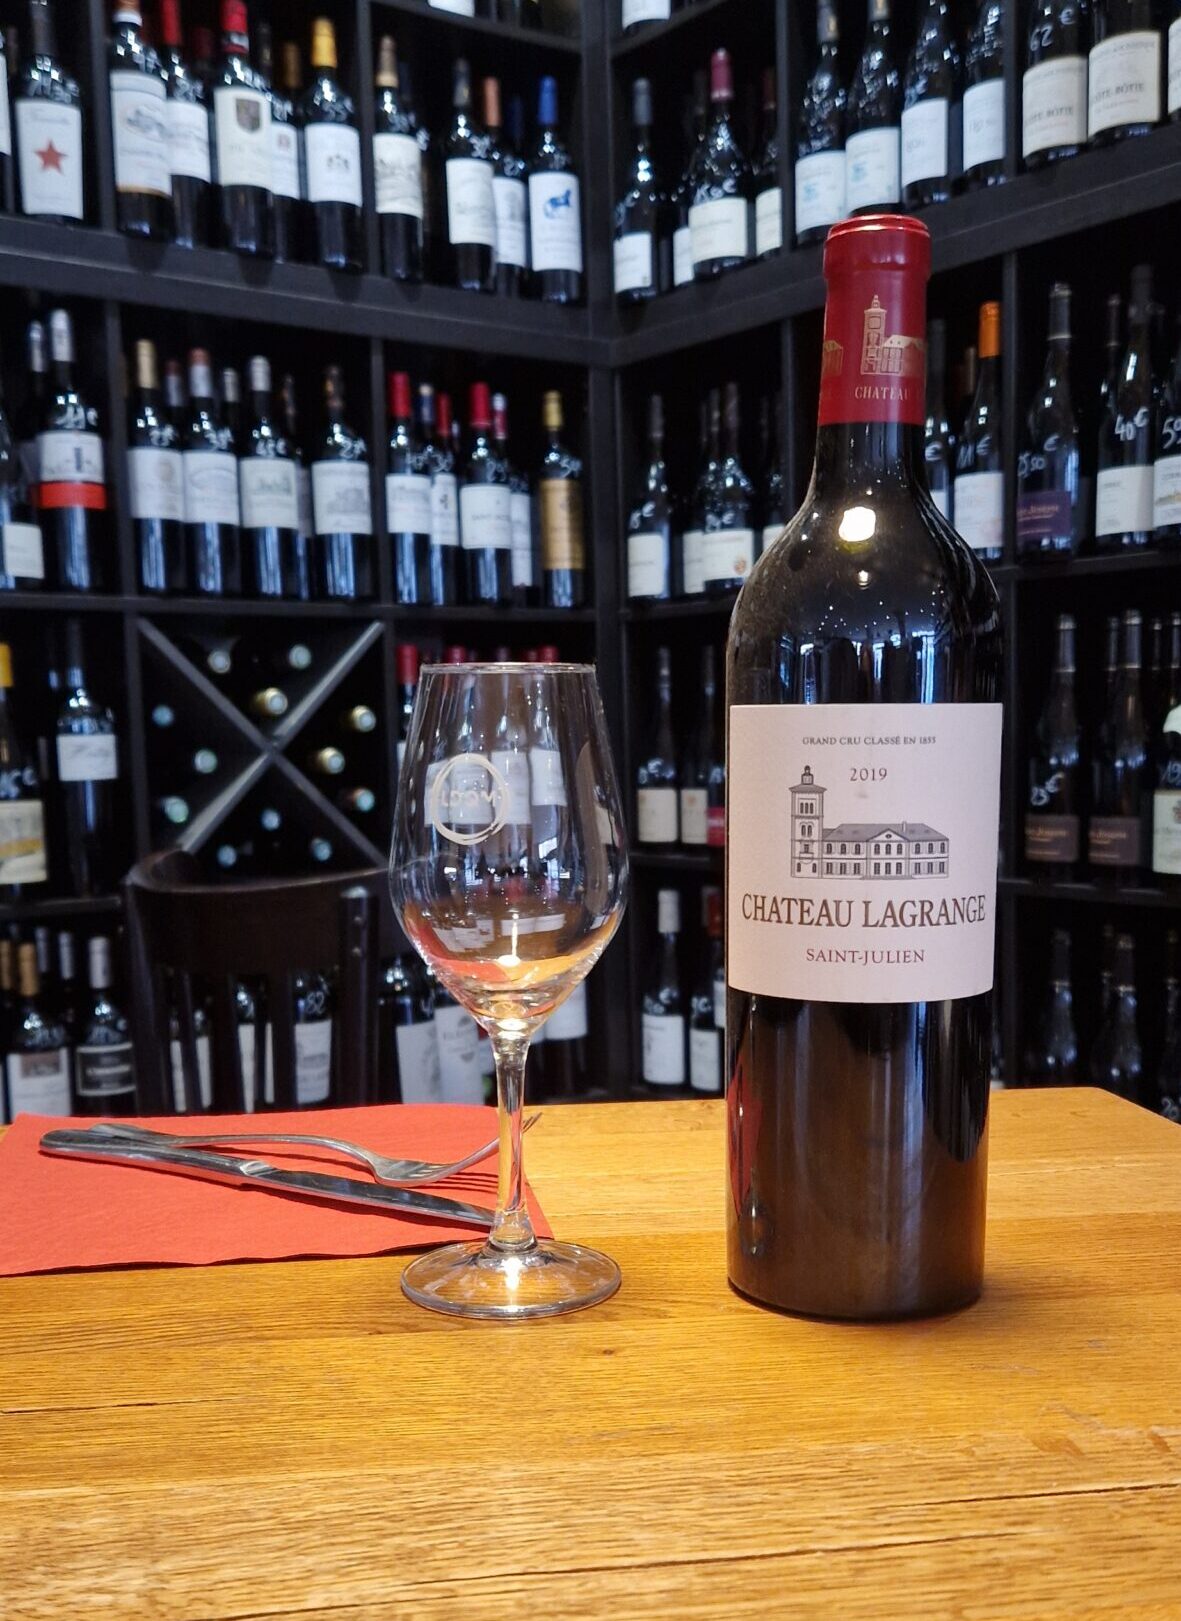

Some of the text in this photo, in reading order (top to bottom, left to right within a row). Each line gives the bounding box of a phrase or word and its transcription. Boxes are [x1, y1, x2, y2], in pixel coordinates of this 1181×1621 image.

[802, 735, 937, 745] GRAND CRU CLASSÉ EN 1855
[850, 767, 888, 781] 2019
[742, 893, 986, 928] CHATEAU LAGRANGE
[806, 949, 925, 966] SAINT-JULIEN
